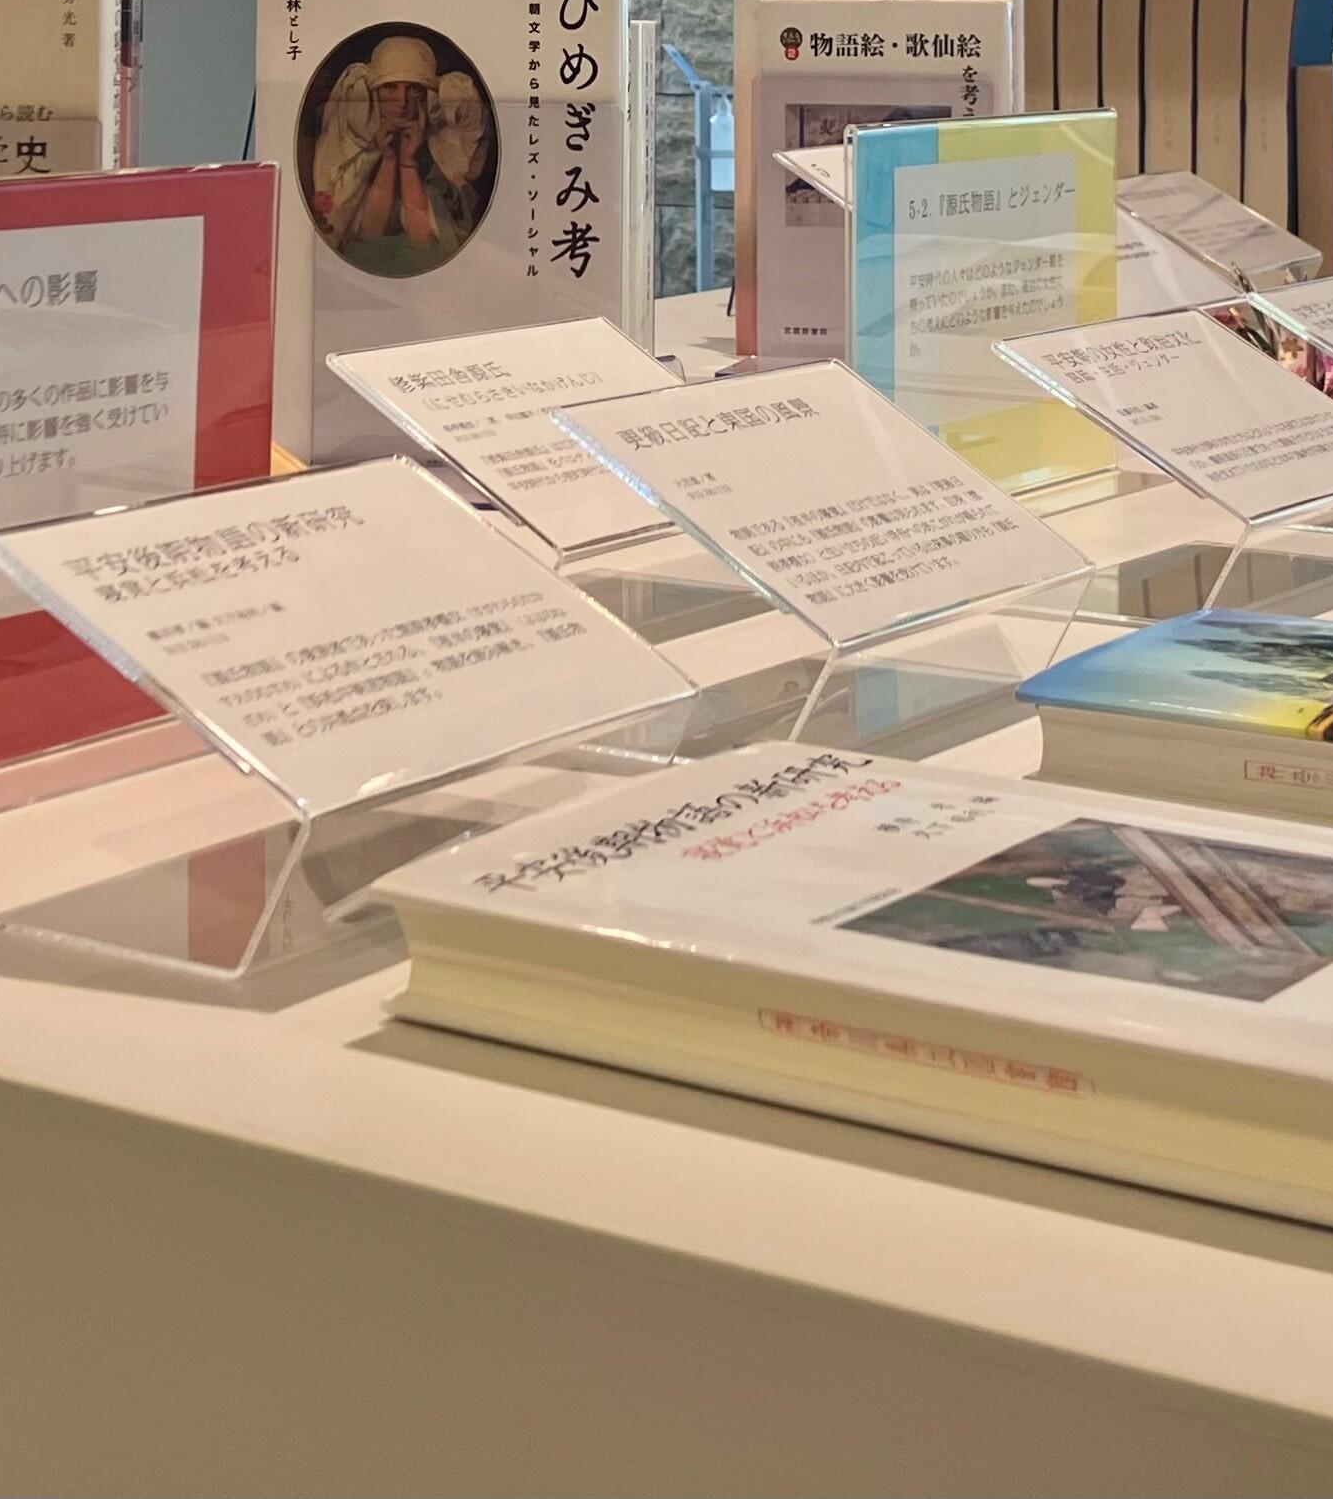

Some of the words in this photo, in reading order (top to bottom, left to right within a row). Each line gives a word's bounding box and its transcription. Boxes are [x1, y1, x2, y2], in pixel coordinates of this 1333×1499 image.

[809, 33, 982, 59] 物語絵・歌仙絵
[616, 397, 821, 451] 更級日記と東国の風景
